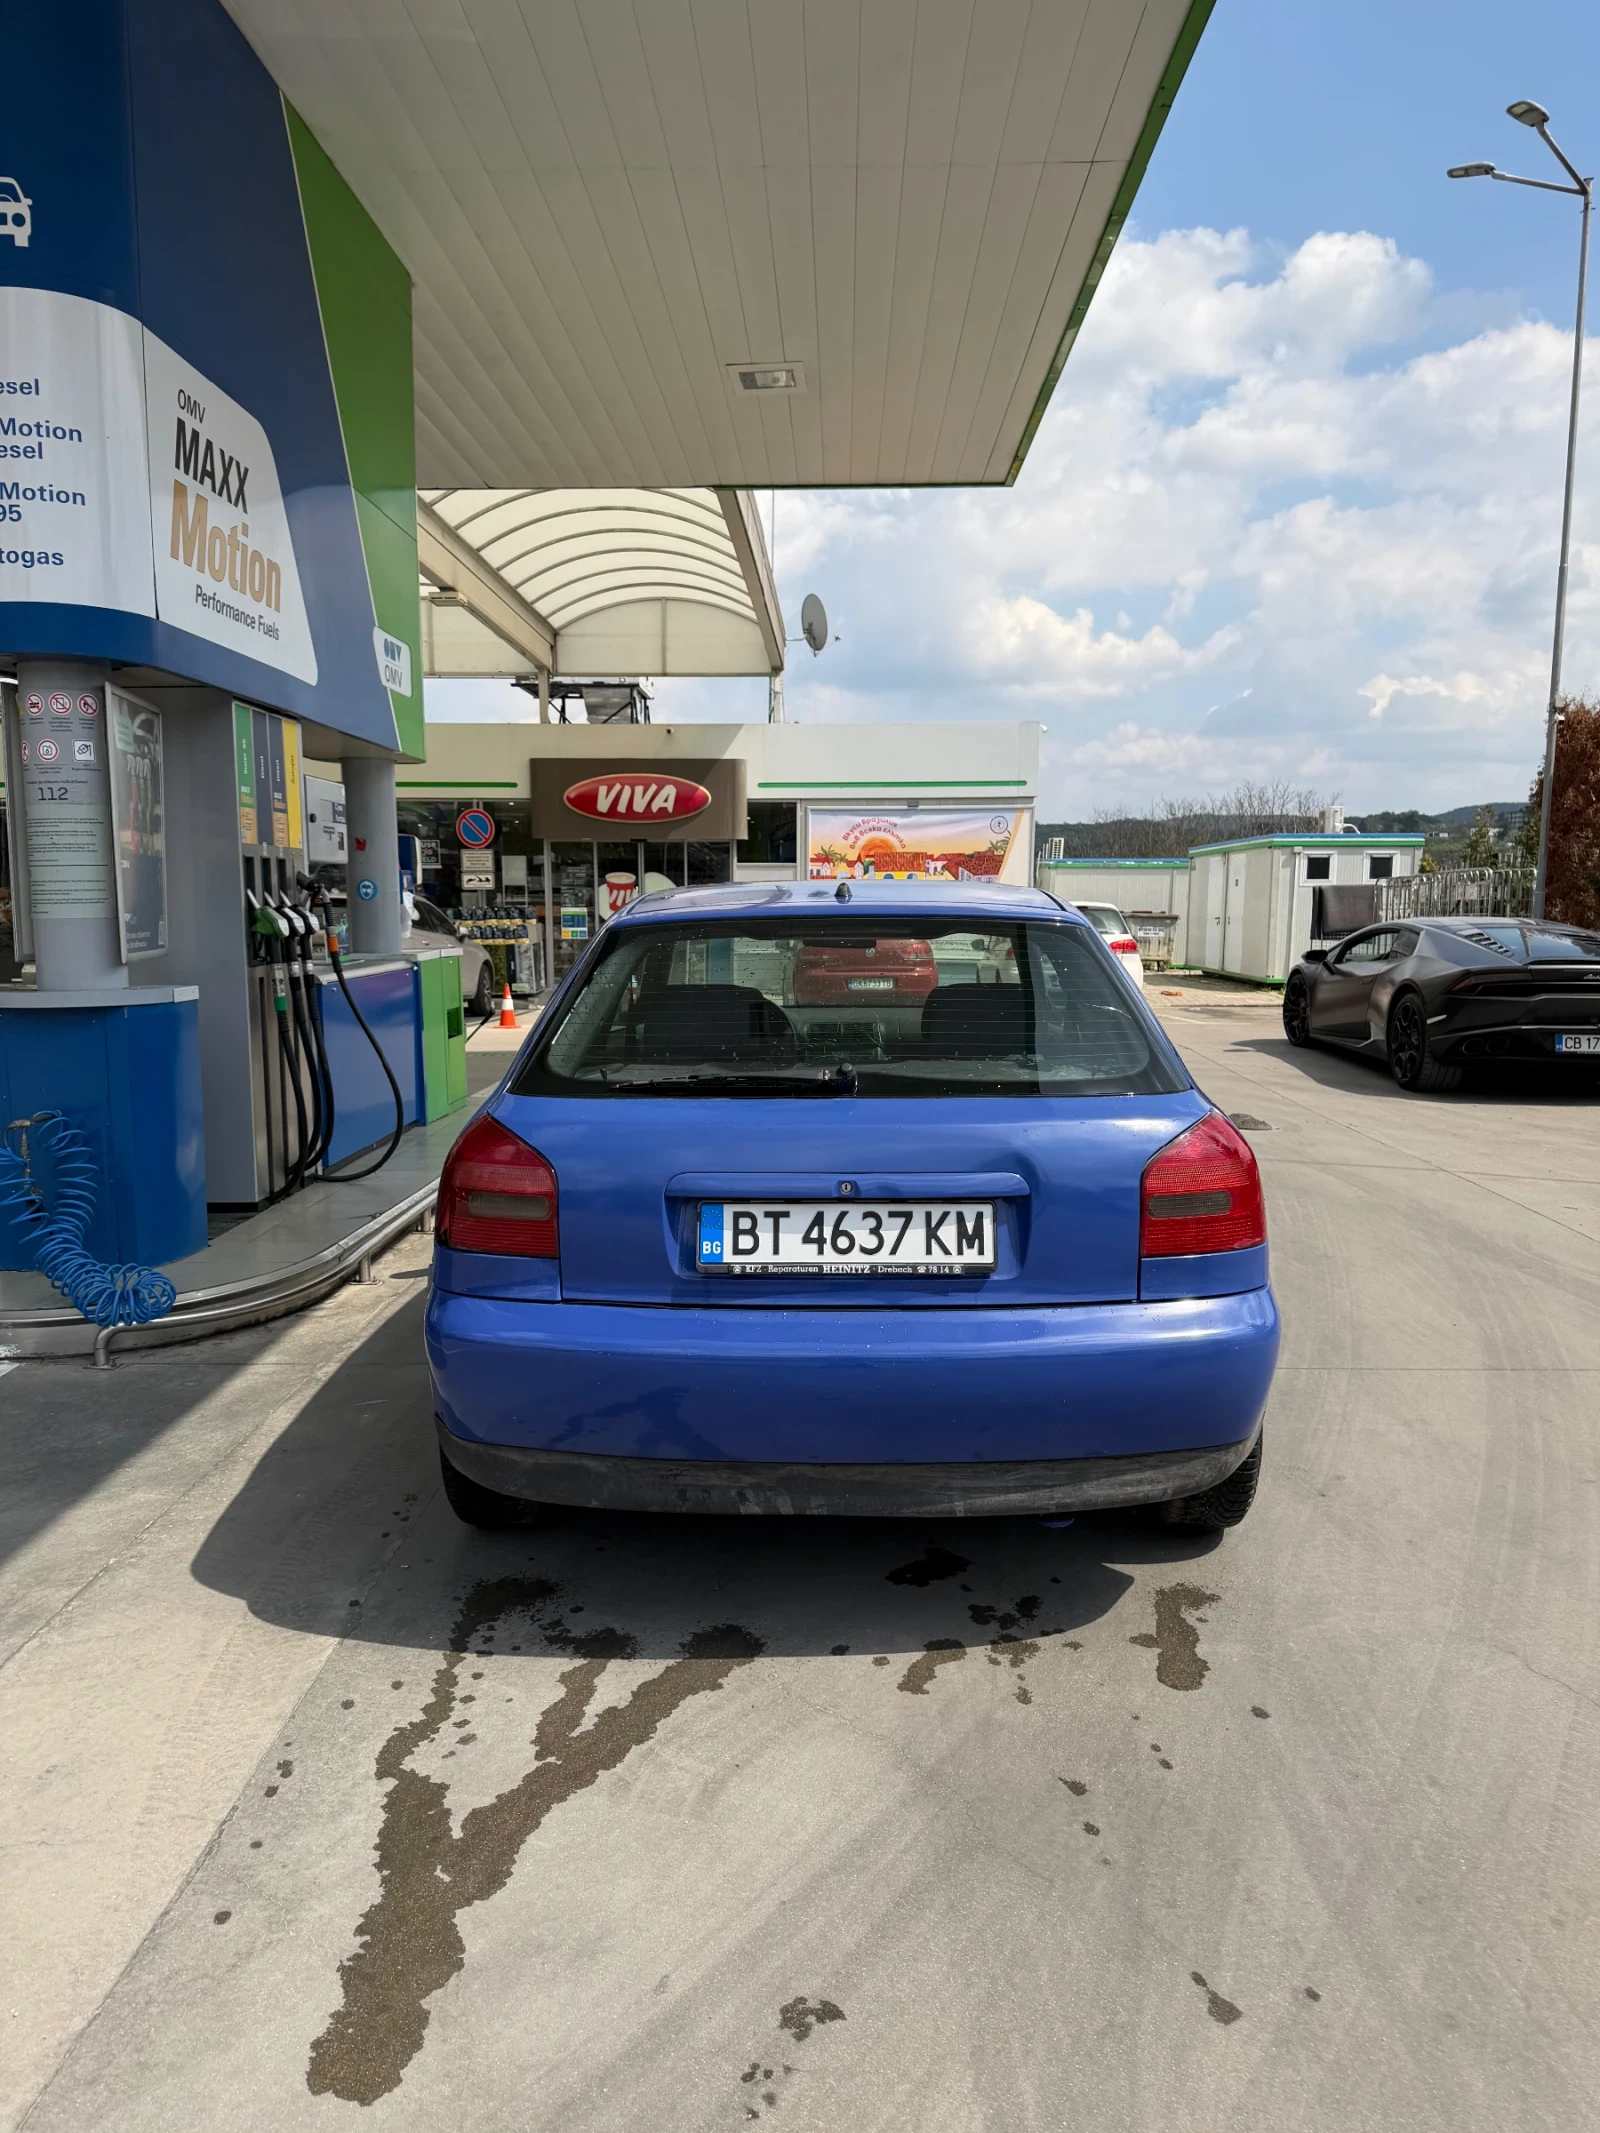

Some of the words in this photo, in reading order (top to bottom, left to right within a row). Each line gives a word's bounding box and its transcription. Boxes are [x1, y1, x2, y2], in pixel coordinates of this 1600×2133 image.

[177, 388, 206, 424] OMV
[0, 417, 83, 443] Motion
[174, 416, 250, 515] MAXX
[0, 481, 86, 506] Motion
[170, 478, 282, 614] Motion
[194, 583, 257, 631] Performance
[257, 614, 280, 642] Fuels
[384, 664, 403, 688] OMV
[38, 786, 69, 801] 112
[596, 782, 677, 814] VIVA
[859, 825, 882, 837] всяка
[1564, 1036, 1582, 1050] CB
[1586, 1036, 1600, 1050] 17
[731, 1210, 791, 1256] BT
[801, 1210, 914, 1256] 4637
[924, 1210, 985, 1256] KM
[702, 1241, 722, 1255] BG
[745, 1265, 762, 1273] KFZ
[767, 1265, 819, 1275] Reparaturen
[822, 1264, 871, 1274] HEINITZ
[877, 1265, 913, 1274] Drebach
[928, 1265, 938, 1273] 78
